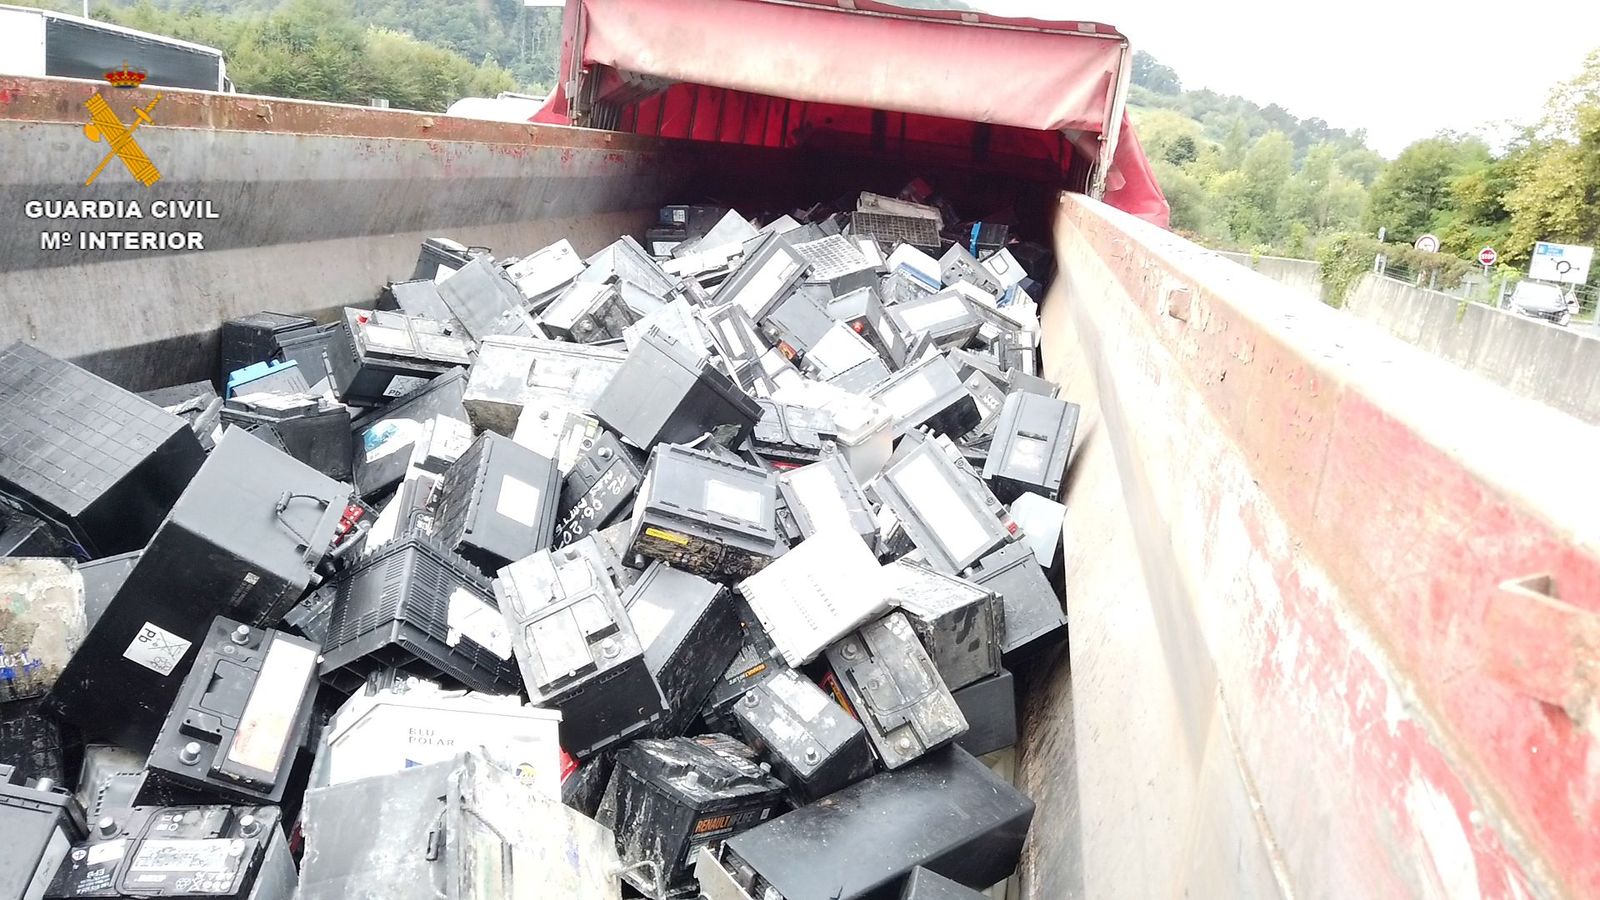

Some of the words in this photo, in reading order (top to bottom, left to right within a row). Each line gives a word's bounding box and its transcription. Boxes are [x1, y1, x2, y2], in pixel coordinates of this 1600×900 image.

[1480, 252, 1495, 260] STOP
[138, 628, 157, 643] Pb
[409, 727, 434, 737] BLU
[409, 736, 454, 746] POLAR
[694, 815, 731, 833] RENAULT
